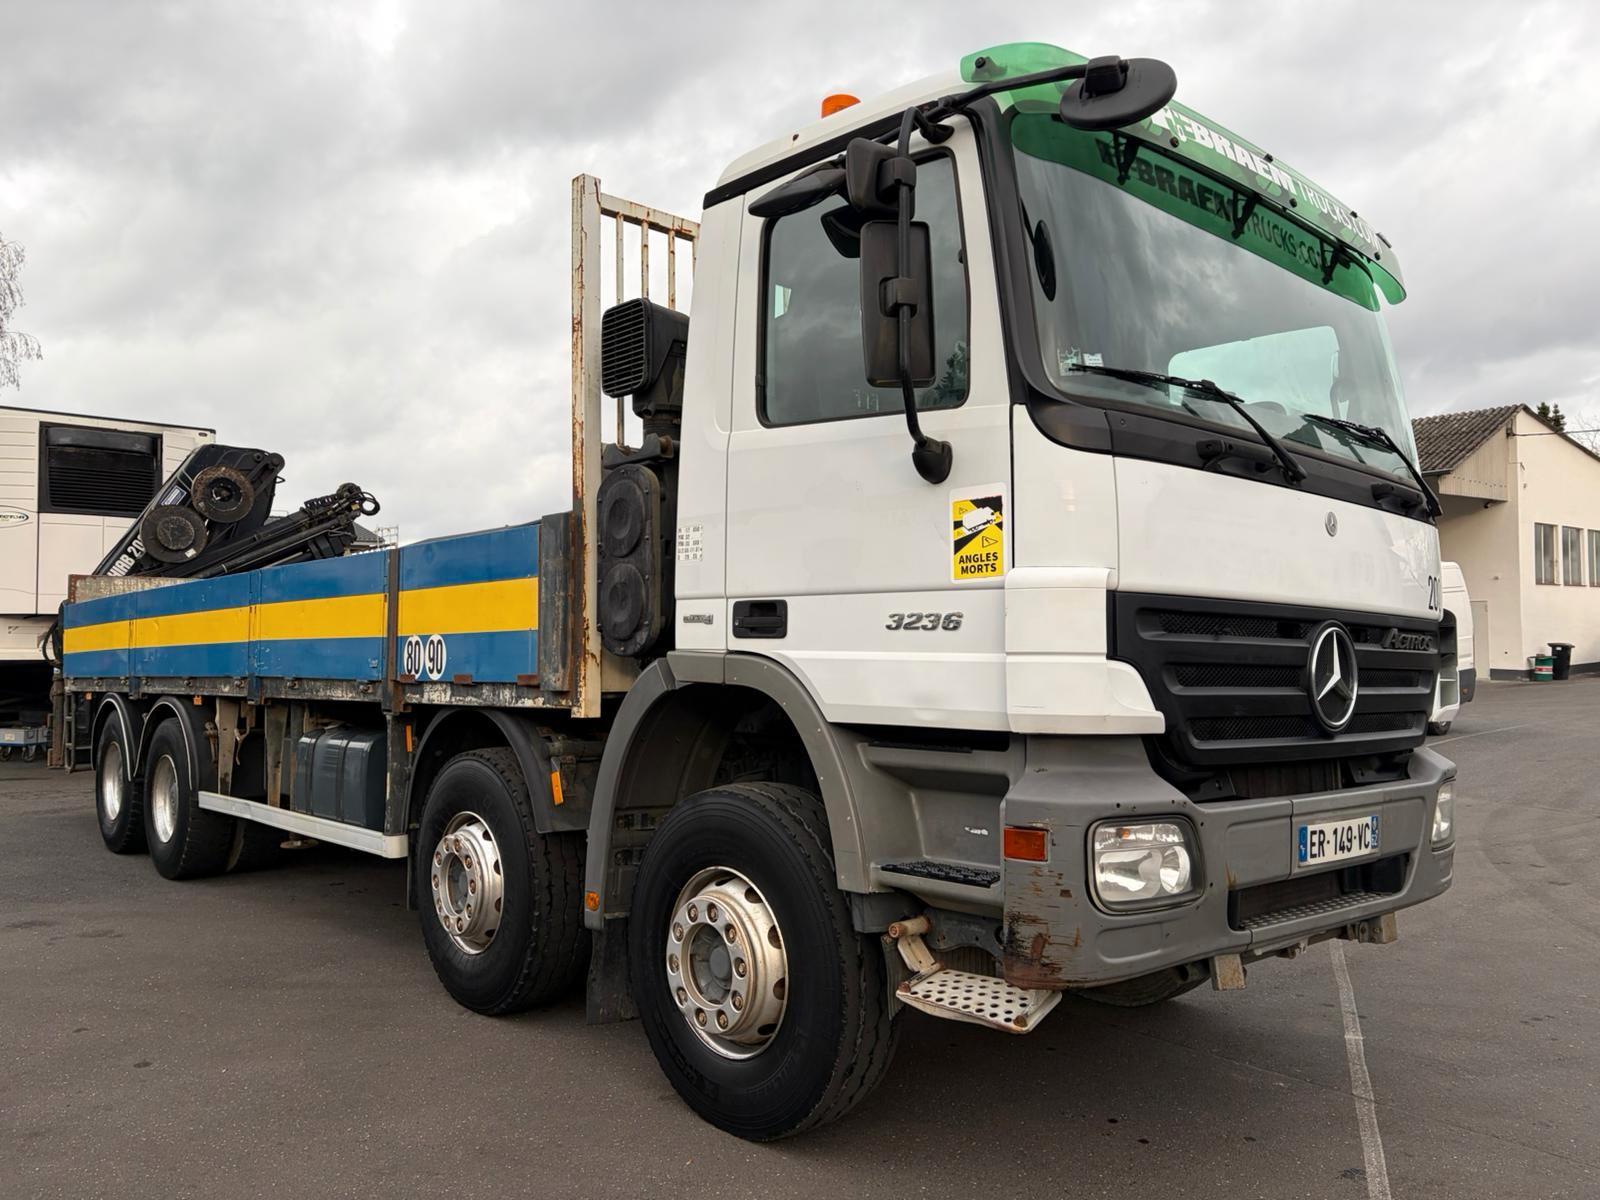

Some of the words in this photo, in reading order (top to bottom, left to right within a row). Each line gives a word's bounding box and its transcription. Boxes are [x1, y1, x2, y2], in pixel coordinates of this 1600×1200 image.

[127, 534, 147, 559] 20
[958, 552, 999, 564] ANGLES
[960, 563, 997, 575] MORTS
[885, 611, 964, 631] 3236
[406, 640, 421, 675] 80
[428, 639, 443, 675] 90
